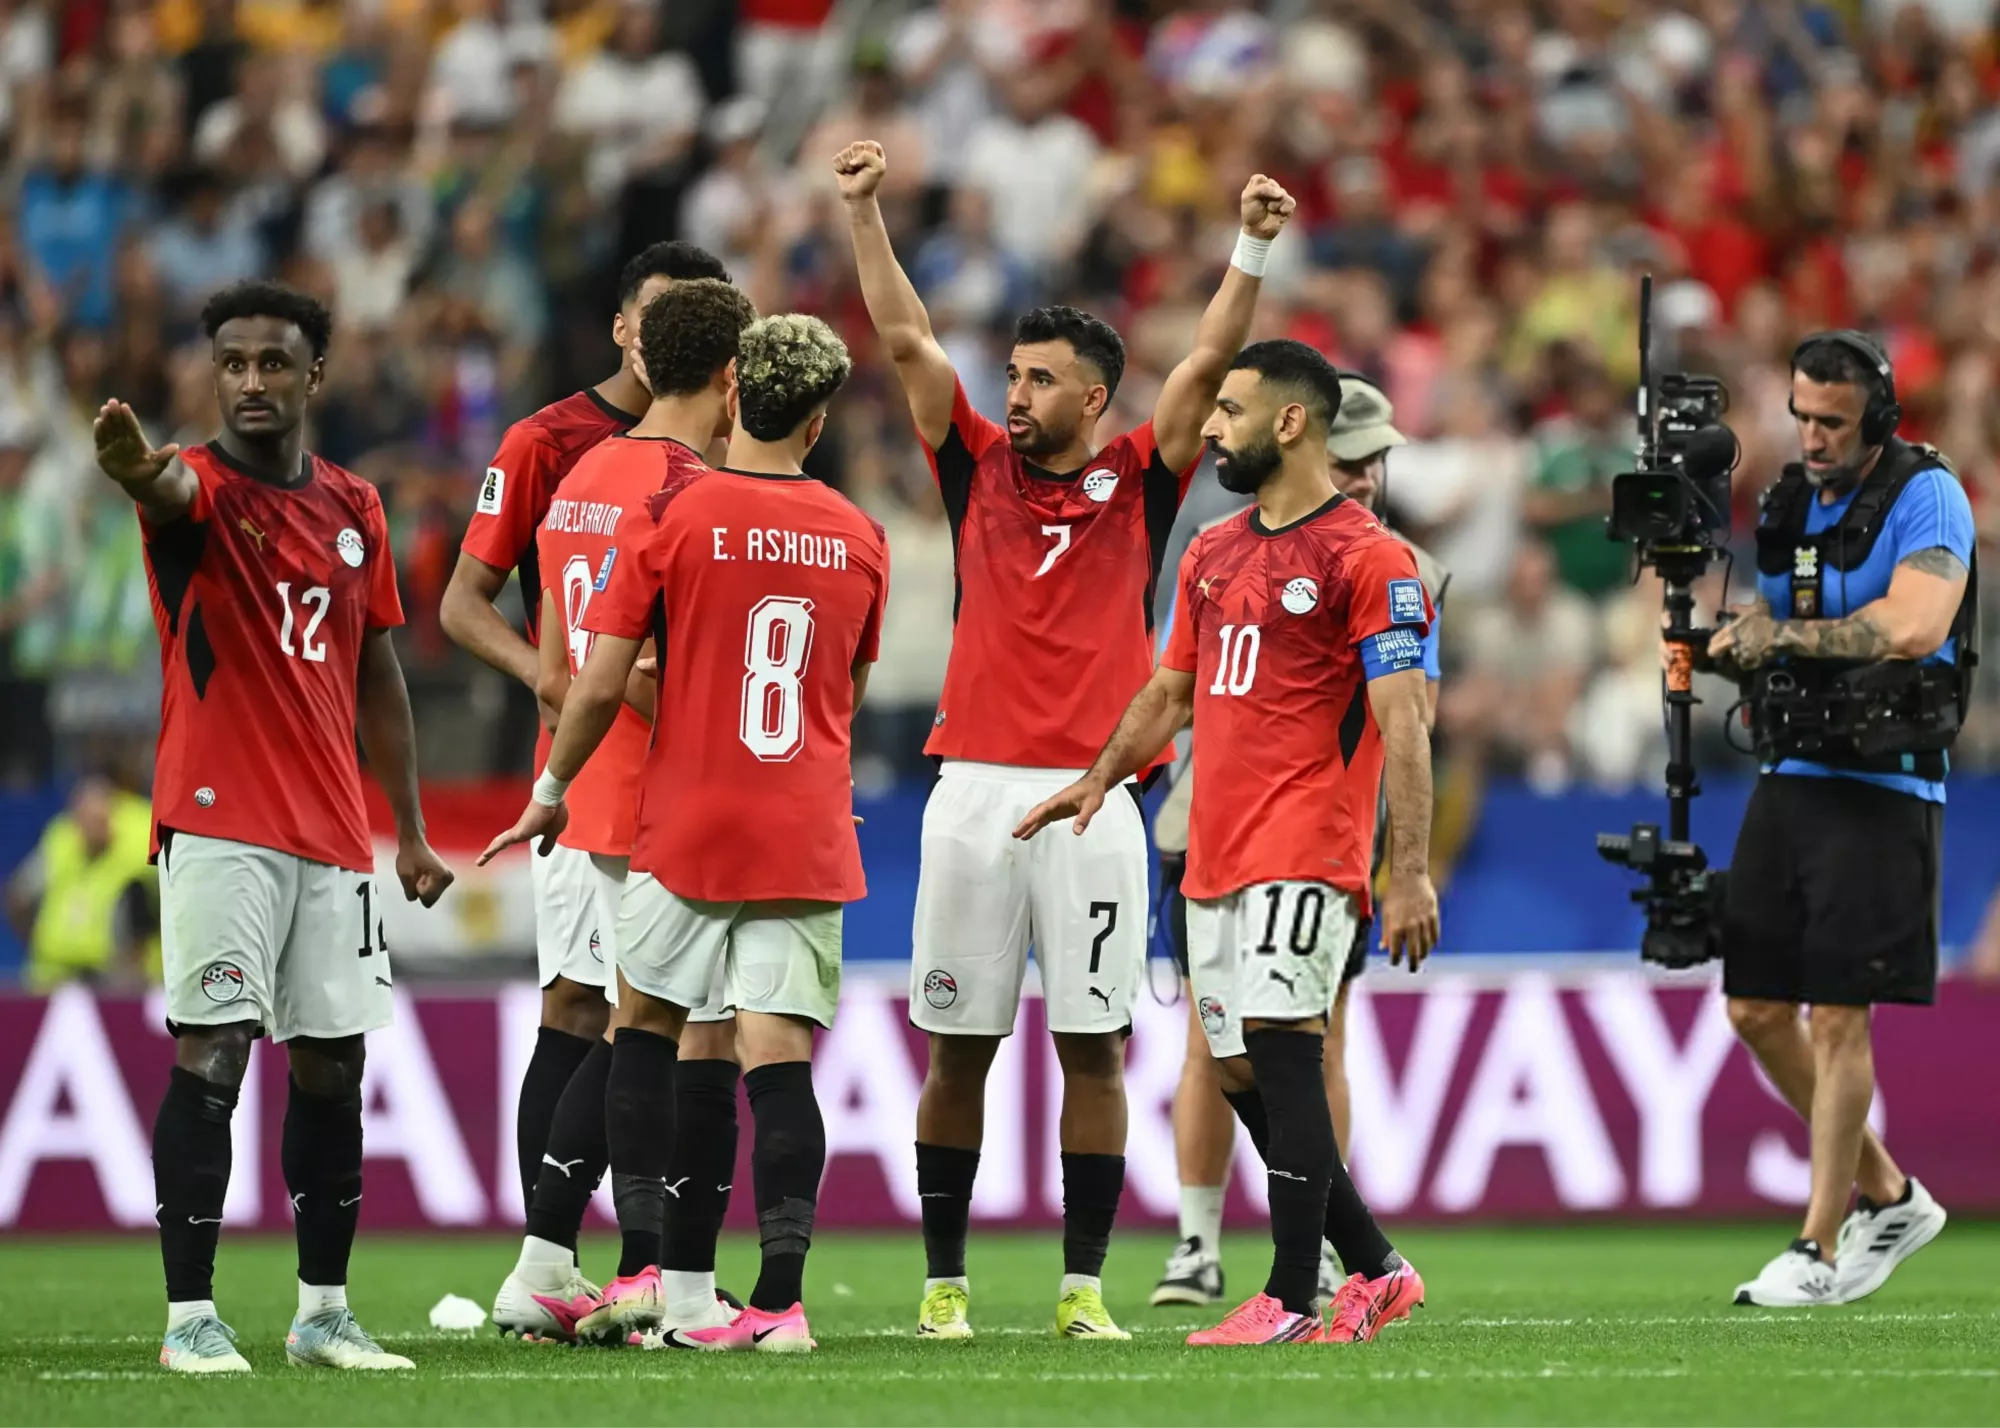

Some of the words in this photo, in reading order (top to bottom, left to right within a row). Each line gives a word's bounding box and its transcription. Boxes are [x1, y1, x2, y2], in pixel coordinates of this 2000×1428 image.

[712, 527, 736, 560] E.
[747, 528, 847, 571] ASHOUR
[1034, 524, 1072, 580] 7
[276, 581, 331, 663] 12
[1375, 629, 1413, 642] FOOTBALL
[1378, 638, 1419, 652] UNITES
[739, 595, 816, 763] 8
[1210, 624, 1261, 696] 10
[1089, 901, 1119, 973] 7
[1256, 885, 1325, 955] 10
